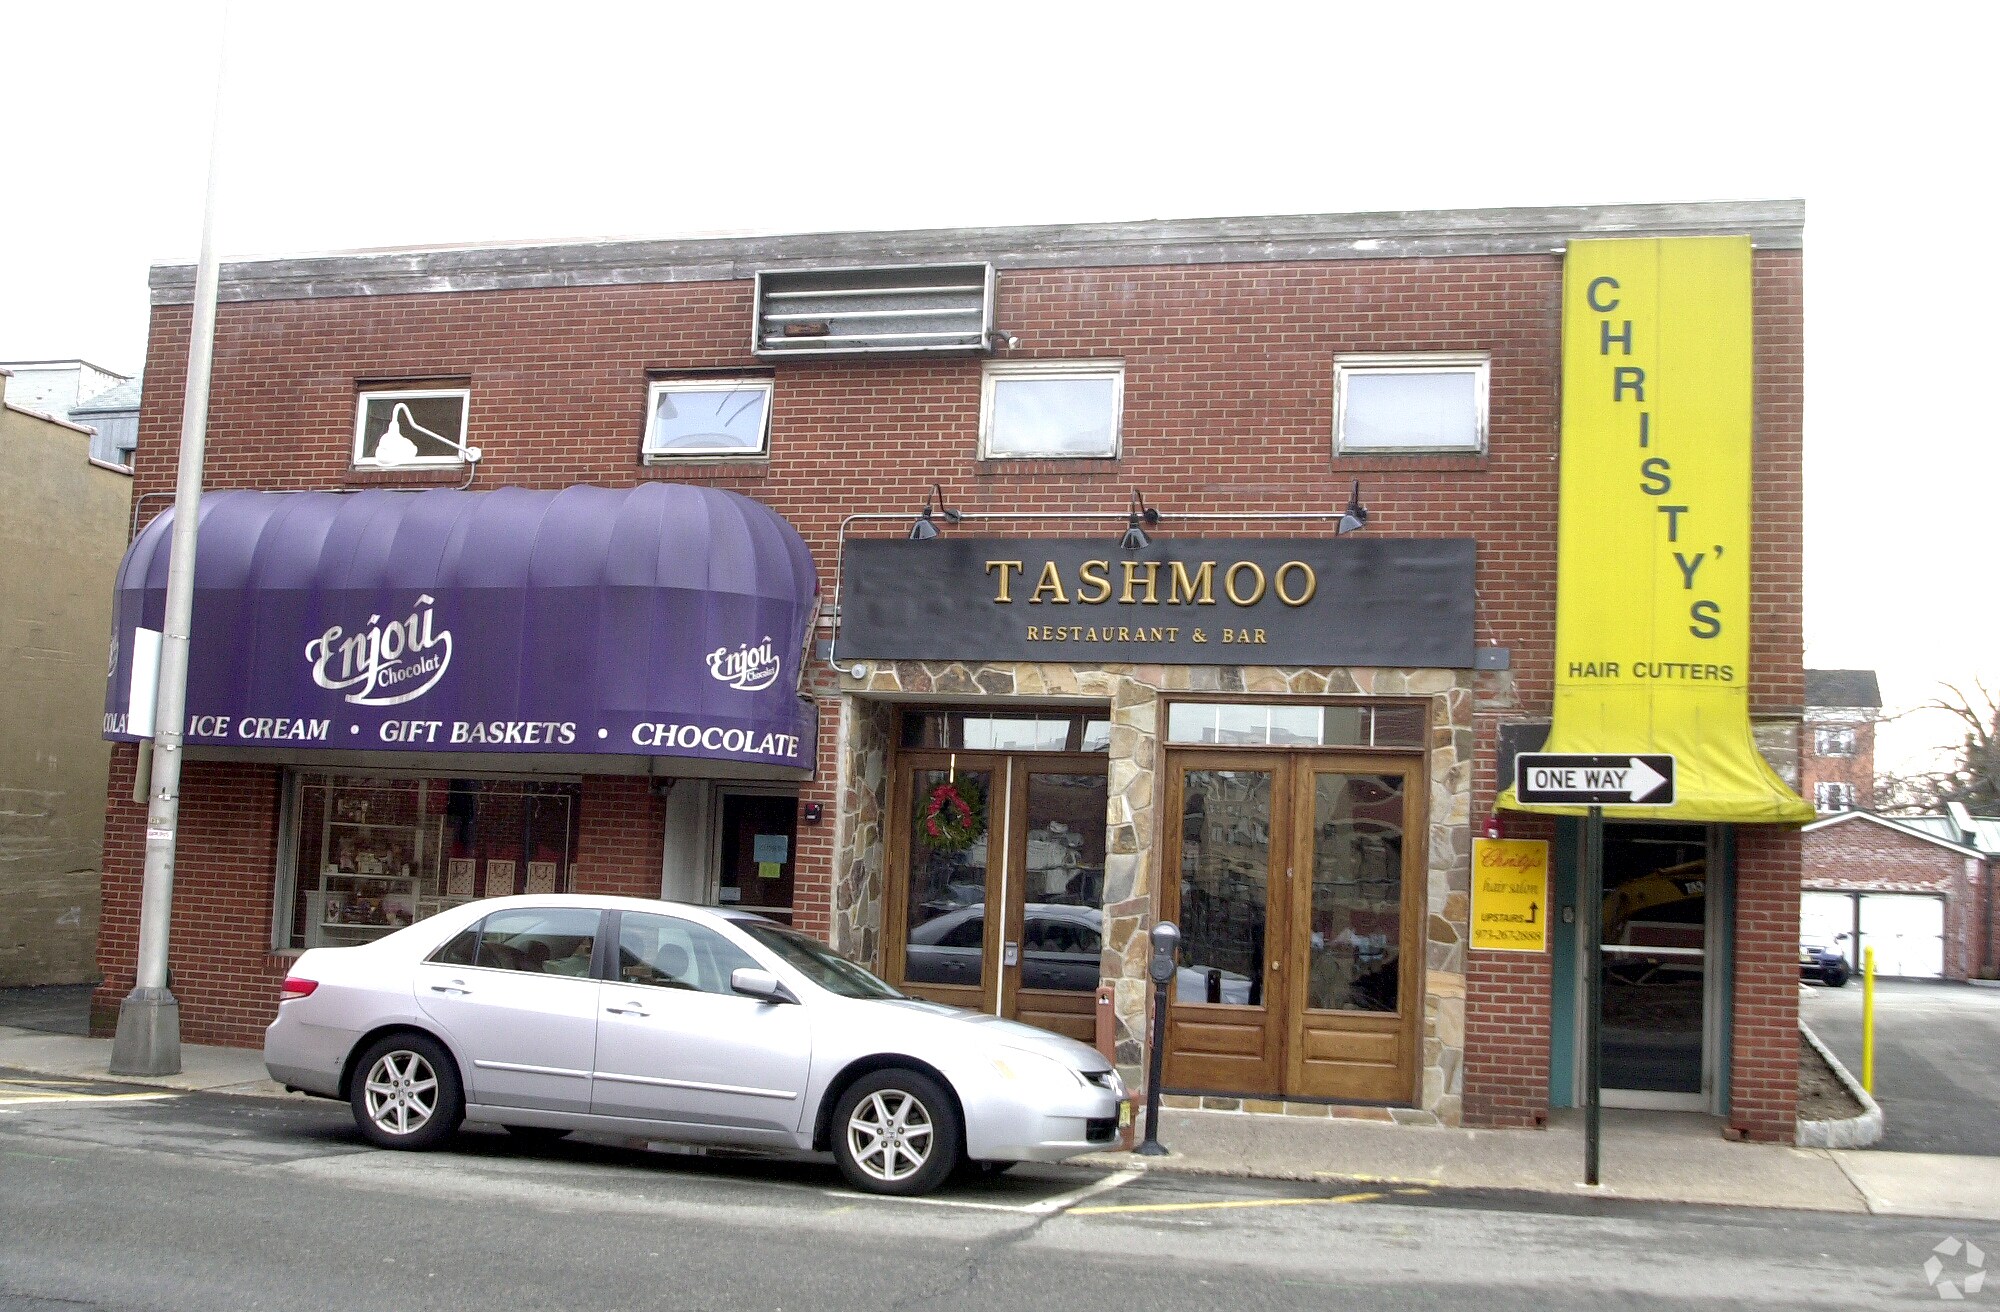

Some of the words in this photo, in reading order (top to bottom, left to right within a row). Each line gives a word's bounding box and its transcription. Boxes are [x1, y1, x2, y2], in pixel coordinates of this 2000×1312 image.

[1586, 276, 1724, 639] CHRISTY'S
[985, 560, 1317, 607] TASHMOO
[1026, 625, 1179, 643] RESTAURANT
[1192, 628, 1207, 643] &
[1222, 628, 1267, 644] BAR
[378, 654, 440, 687] Chocolat
[1568, 661, 1620, 678] HAIR
[1632, 662, 1734, 682] CUTTERS
[188, 715, 231, 737] ICE
[238, 717, 331, 741] CREAM
[379, 720, 443, 743] GIFT
[450, 721, 577, 744] BASKETS
[631, 722, 800, 757] CHOCOLATE
[1535, 770, 1577, 789] ONE
[1584, 770, 1628, 789] WAY
[1481, 913, 1524, 923] UPSTAIRS
